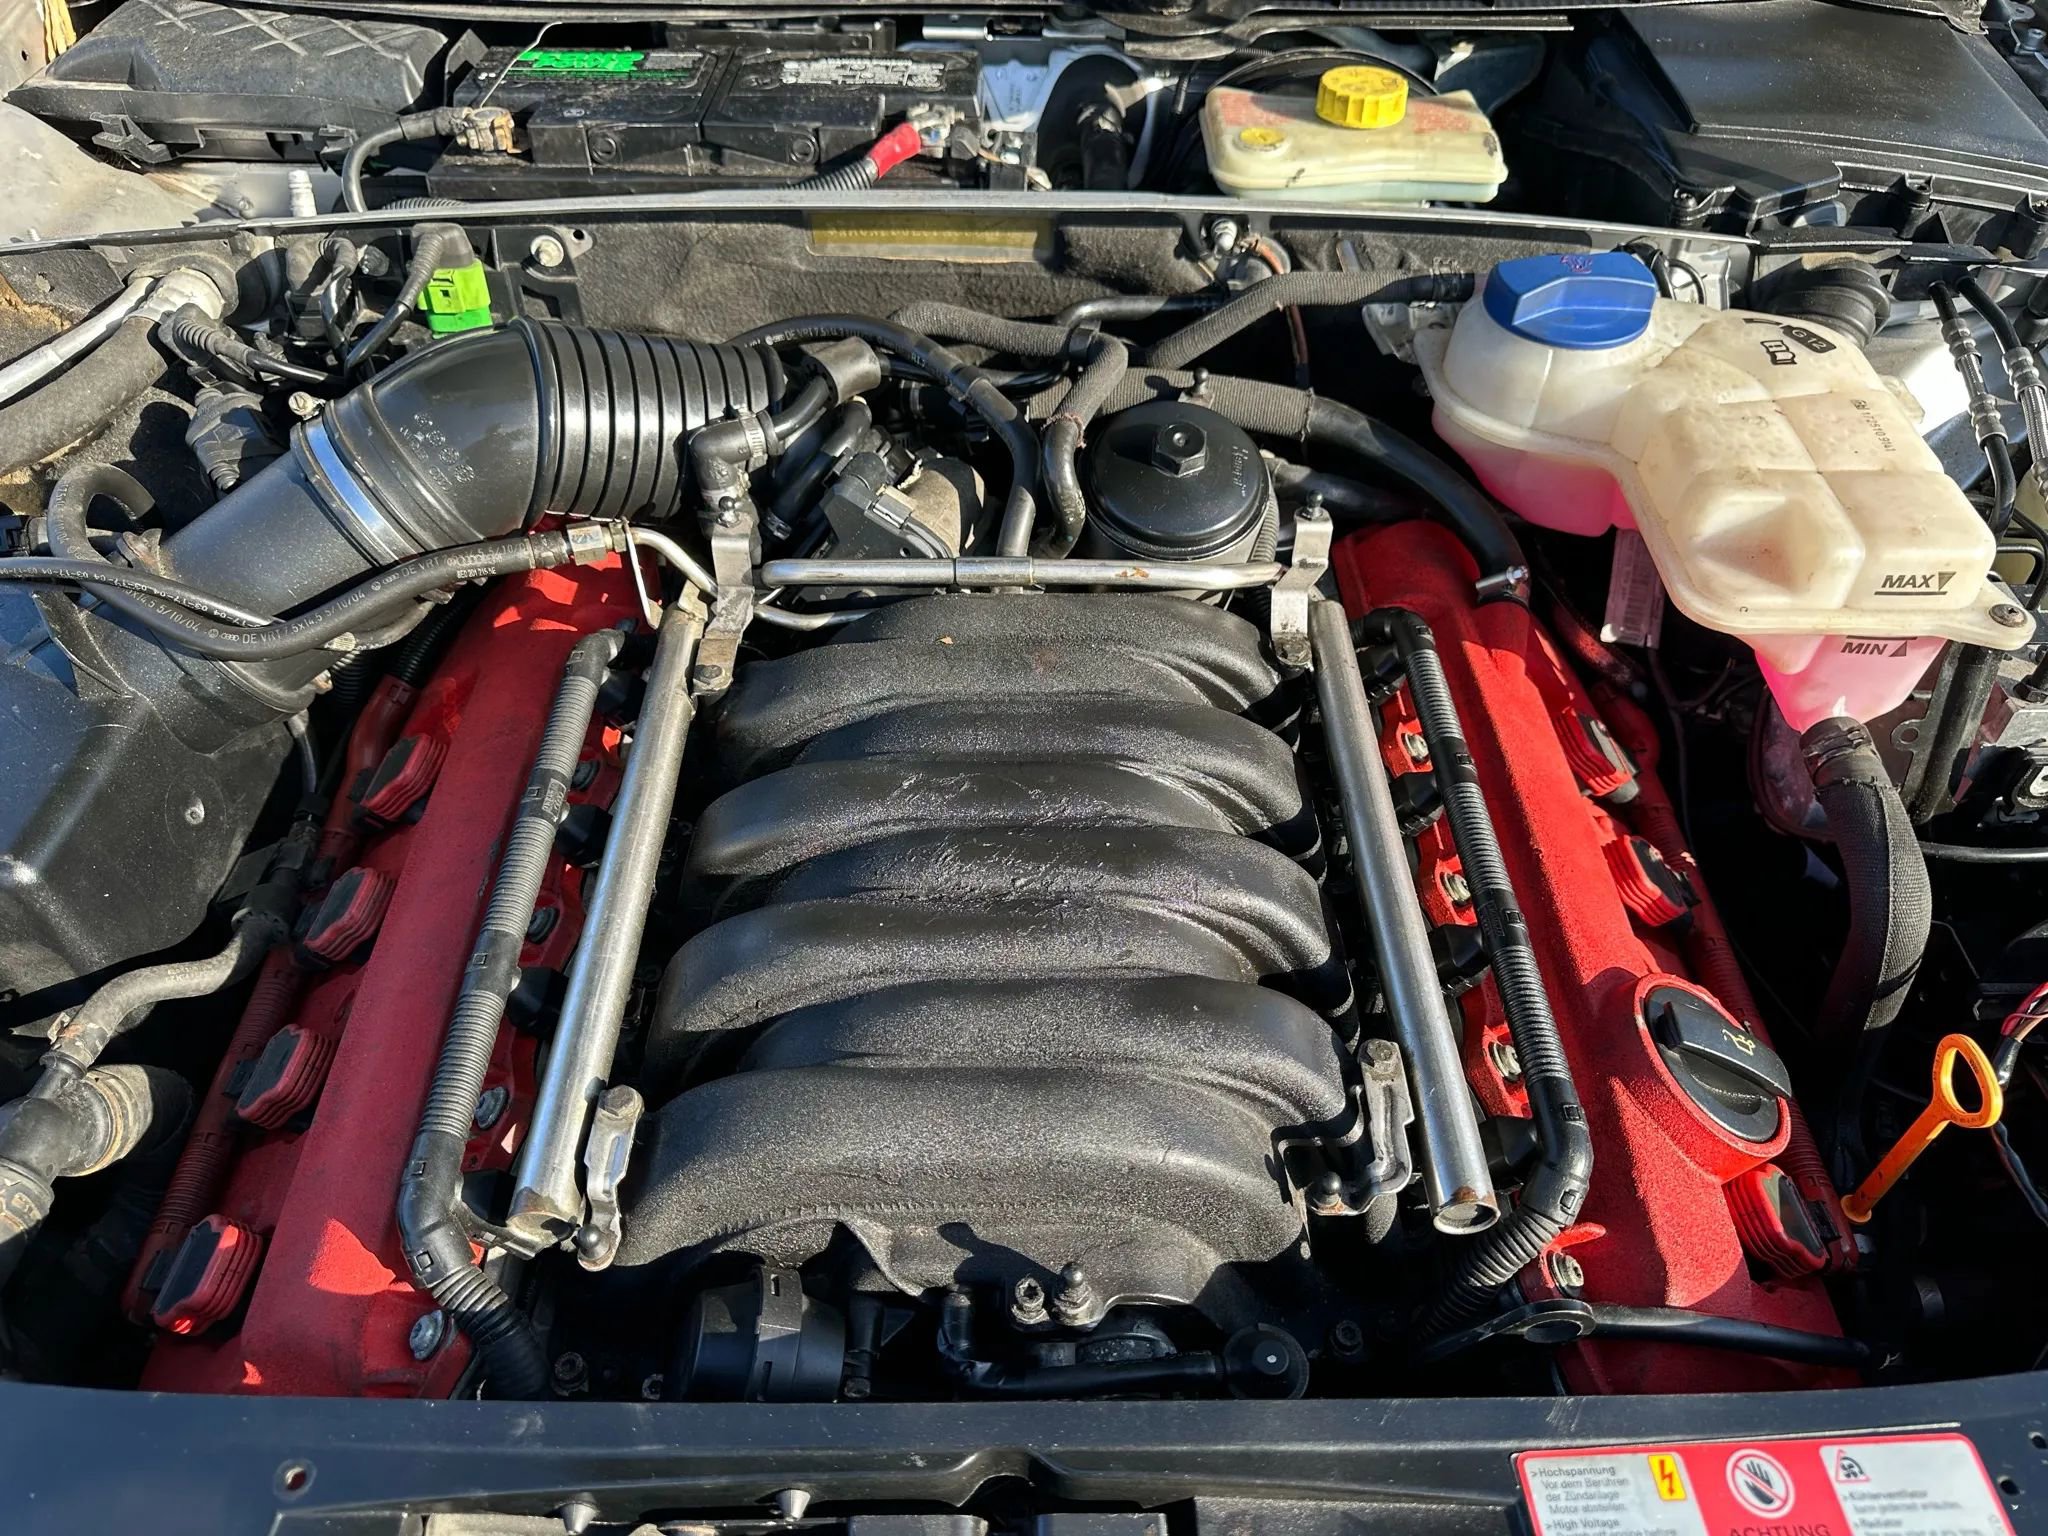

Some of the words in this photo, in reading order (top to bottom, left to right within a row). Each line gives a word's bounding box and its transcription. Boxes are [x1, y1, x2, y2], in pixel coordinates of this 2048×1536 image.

[1881, 574, 1935, 588] MAX
[242, 632, 258, 645] DE
[260, 629, 282, 643] VRT
[1840, 641, 1888, 656] MIN
[1730, 1524, 1831, 1536] ACHTUNG
